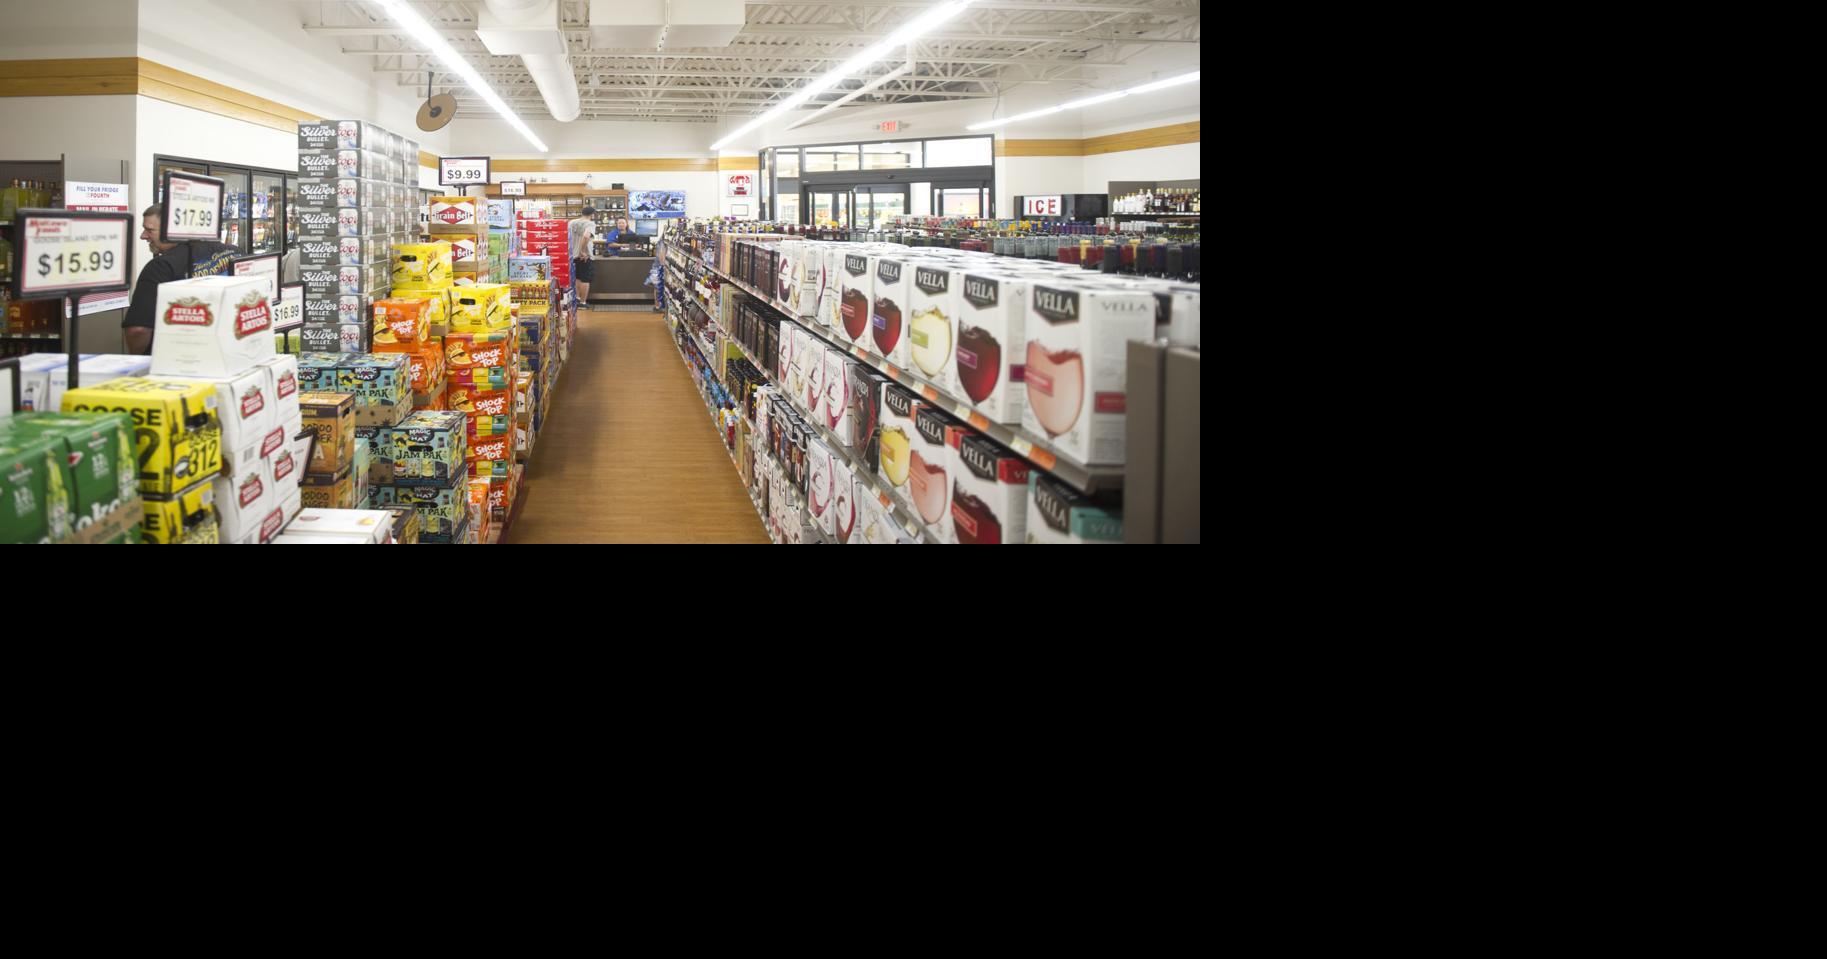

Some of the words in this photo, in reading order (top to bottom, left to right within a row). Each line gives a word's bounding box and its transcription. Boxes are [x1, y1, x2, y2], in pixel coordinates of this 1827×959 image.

[300, 126, 336, 136] Silver
[881, 122, 896, 131] EXIT
[300, 156, 336, 166] Silver
[447, 170, 481, 180] $9.99
[300, 185, 336, 195] Silver
[1029, 199, 1056, 214] ICE
[174, 208, 212, 227] $17.99
[301, 214, 337, 224] Silver
[303, 243, 338, 253] Silver
[38, 250, 114, 277] $15.99
[847, 257, 865, 271] VELLA
[880, 263, 898, 278] VELLA
[302, 272, 338, 282] Silver
[918, 271, 945, 288] VELLA
[966, 280, 994, 300] VELLA
[305, 301, 338, 311] Silver
[1036, 291, 1074, 314] VELLA
[1102, 302, 1148, 312] VELLA
[241, 307, 266, 320] STELLA
[274, 305, 299, 321] $16.99
[303, 330, 338, 340] Silver
[472, 349, 502, 361] SHOCK
[480, 357, 499, 367] TOP
[476, 397, 506, 410] SHOCK
[888, 392, 908, 414] VELLA
[485, 405, 502, 415] TOP
[917, 414, 942, 440] VELLA
[475, 442, 506, 454] SHOCK
[189, 439, 218, 476] 312
[396, 450, 419, 460] JAM
[423, 450, 443, 460] PAK
[485, 450, 502, 460] TOP
[962, 444, 994, 476] VELLA
[428, 507, 448, 517] PAK
[1036, 485, 1066, 527] VELLA
